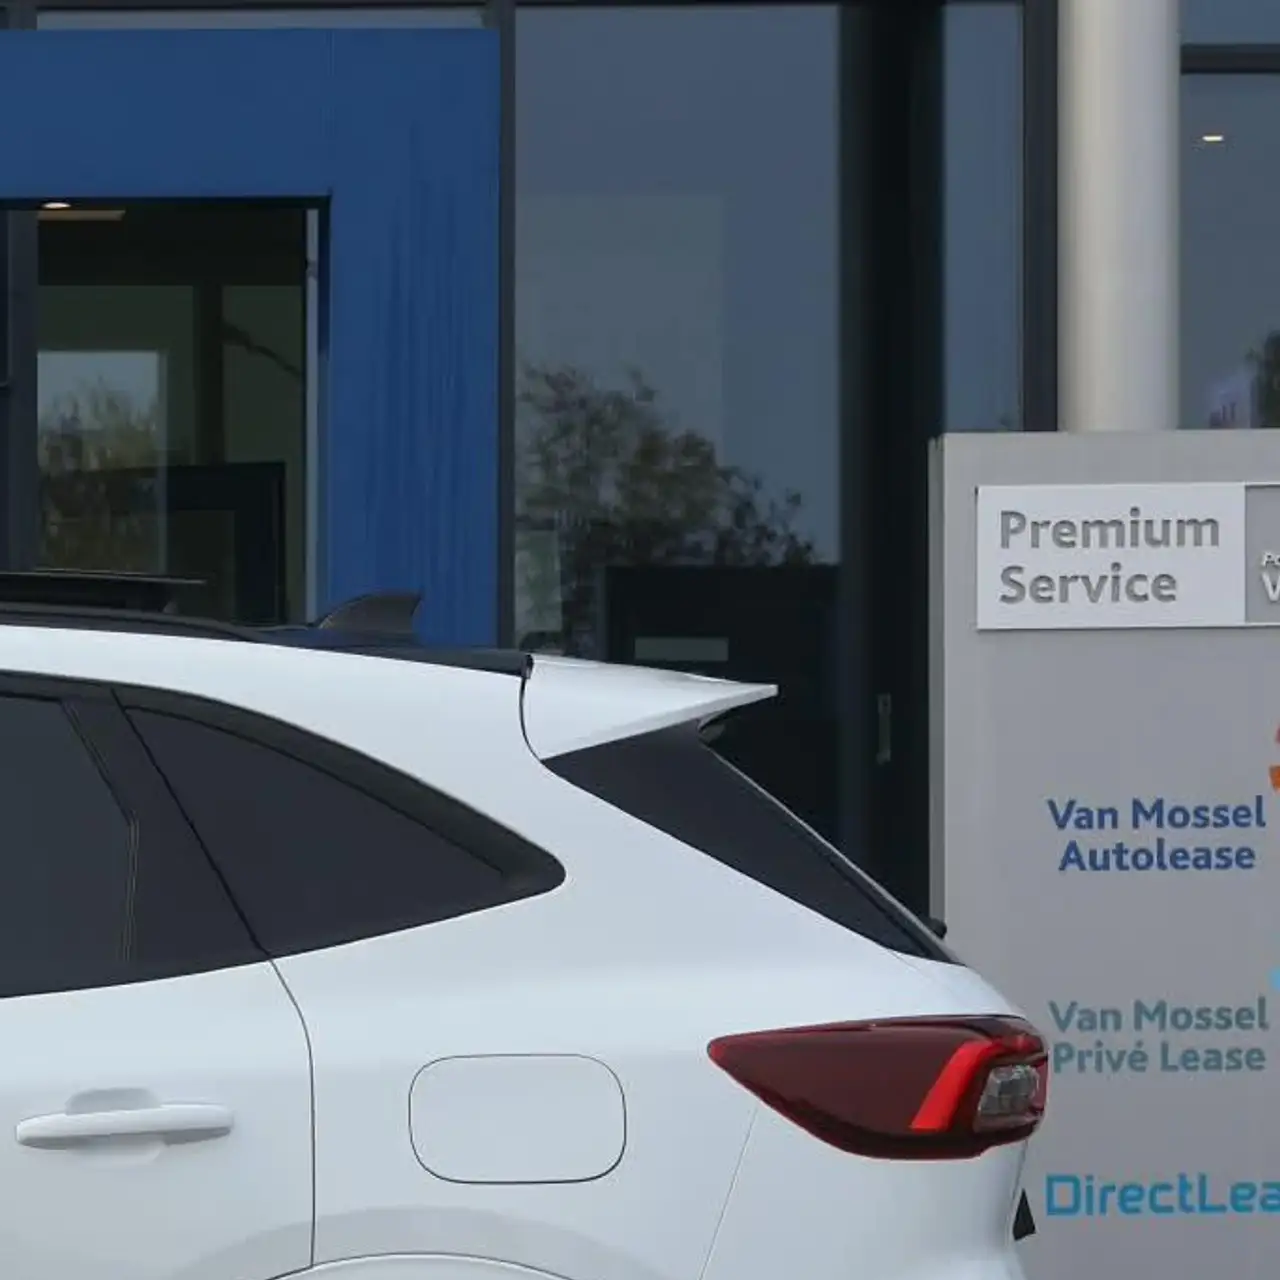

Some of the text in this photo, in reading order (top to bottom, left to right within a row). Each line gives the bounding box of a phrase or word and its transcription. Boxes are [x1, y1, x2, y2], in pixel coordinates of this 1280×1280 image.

[1001, 506, 1219, 548] Premium
[1000, 562, 1176, 604] Service
[1047, 795, 1266, 830] Van Mossel
[1058, 837, 1255, 871] Autolease
[1048, 996, 1269, 1033] Van Mossel
[1053, 1040, 1266, 1073] Privé Lease
